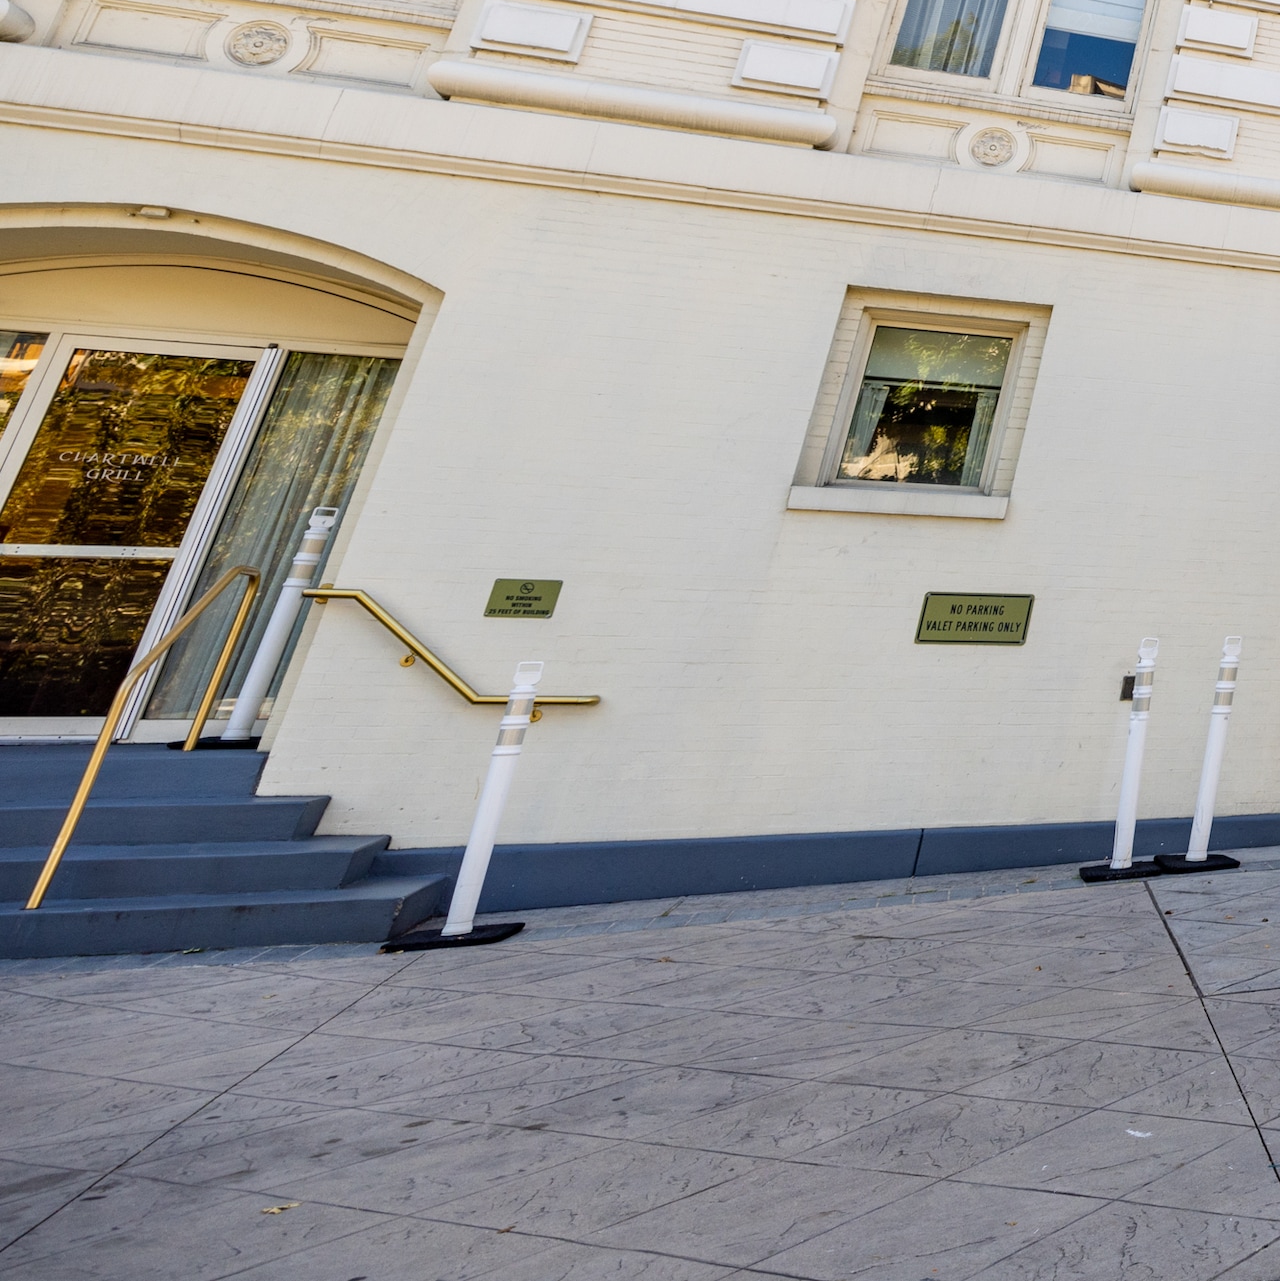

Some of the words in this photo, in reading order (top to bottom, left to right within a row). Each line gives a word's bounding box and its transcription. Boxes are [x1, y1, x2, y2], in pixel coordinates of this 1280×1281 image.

[86, 468, 145, 484] GRILL
[950, 604, 963, 615] NO
[966, 604, 1005, 616] PARKING
[926, 620, 953, 631] VALET
[955, 621, 995, 632] PARKING
[997, 622, 1022, 633] ONLY
